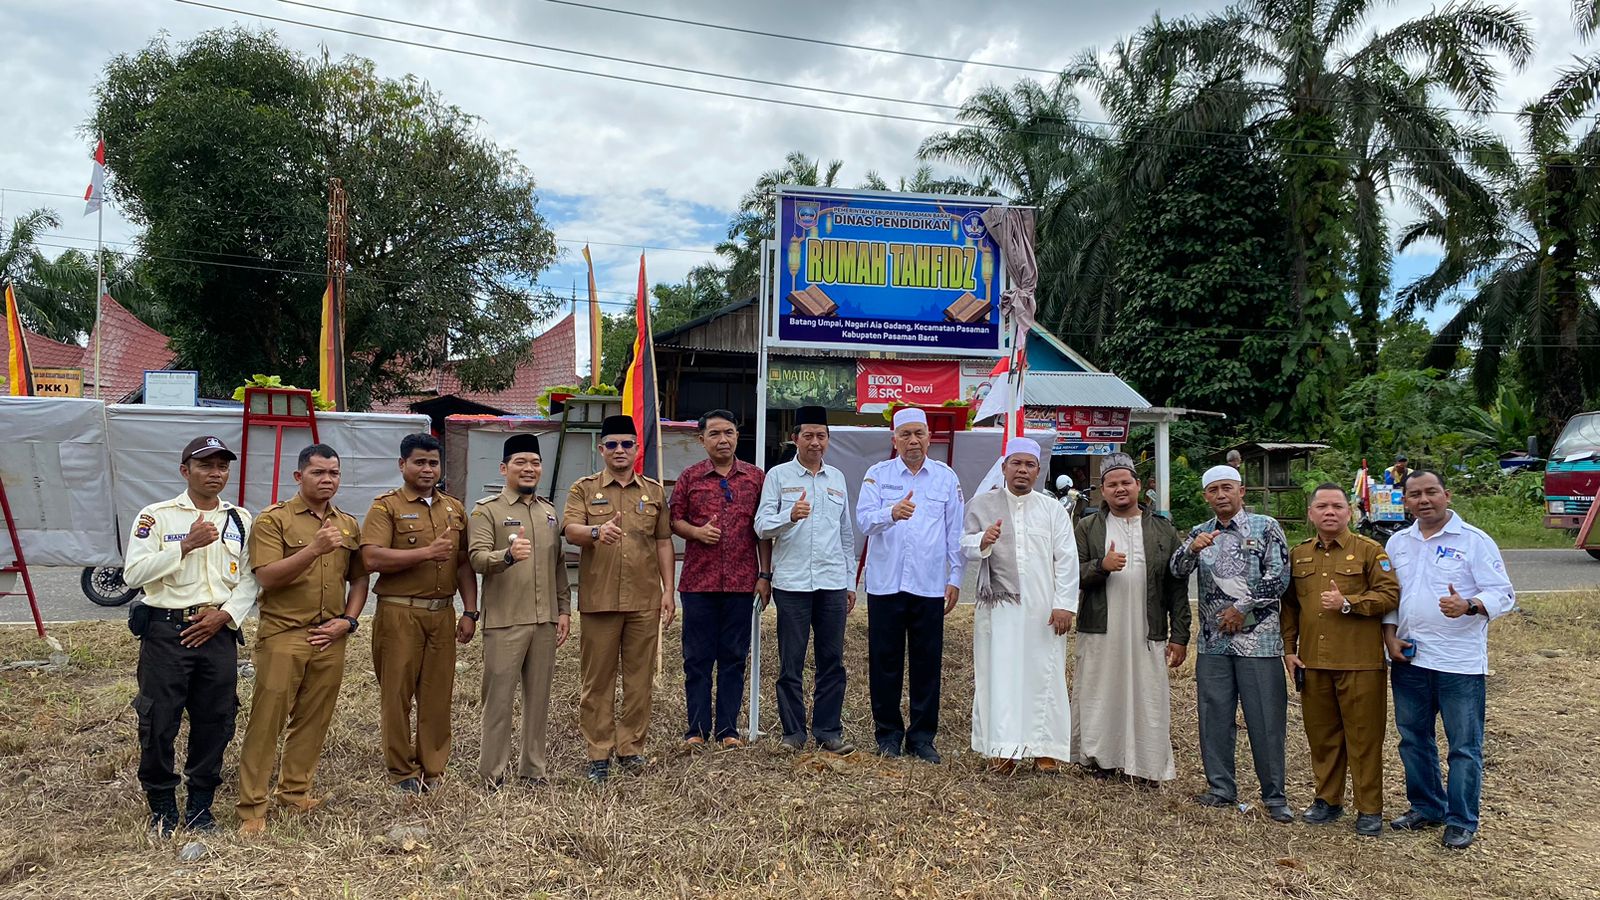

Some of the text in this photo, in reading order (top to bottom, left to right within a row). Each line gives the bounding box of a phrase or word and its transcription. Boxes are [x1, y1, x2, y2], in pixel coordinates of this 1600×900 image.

[833, 207, 870, 215] PEMERINTAH
[870, 209, 905, 217] KABUPATEN
[834, 214, 951, 231] DINAS PENDIDIKAN
[806, 238, 977, 290] RUMAH TAHFIDZ
[789, 318, 990, 334] Batang Umpai, Nagari Aia Gadang, Kecamatan Pasaman
[841, 331, 939, 342] Kabupaten Pasaman Barat
[782, 369, 816, 381] MATRA
[872, 375, 899, 384] TOKO
[879, 388, 902, 398] SRC
[905, 383, 933, 394] Dewi
